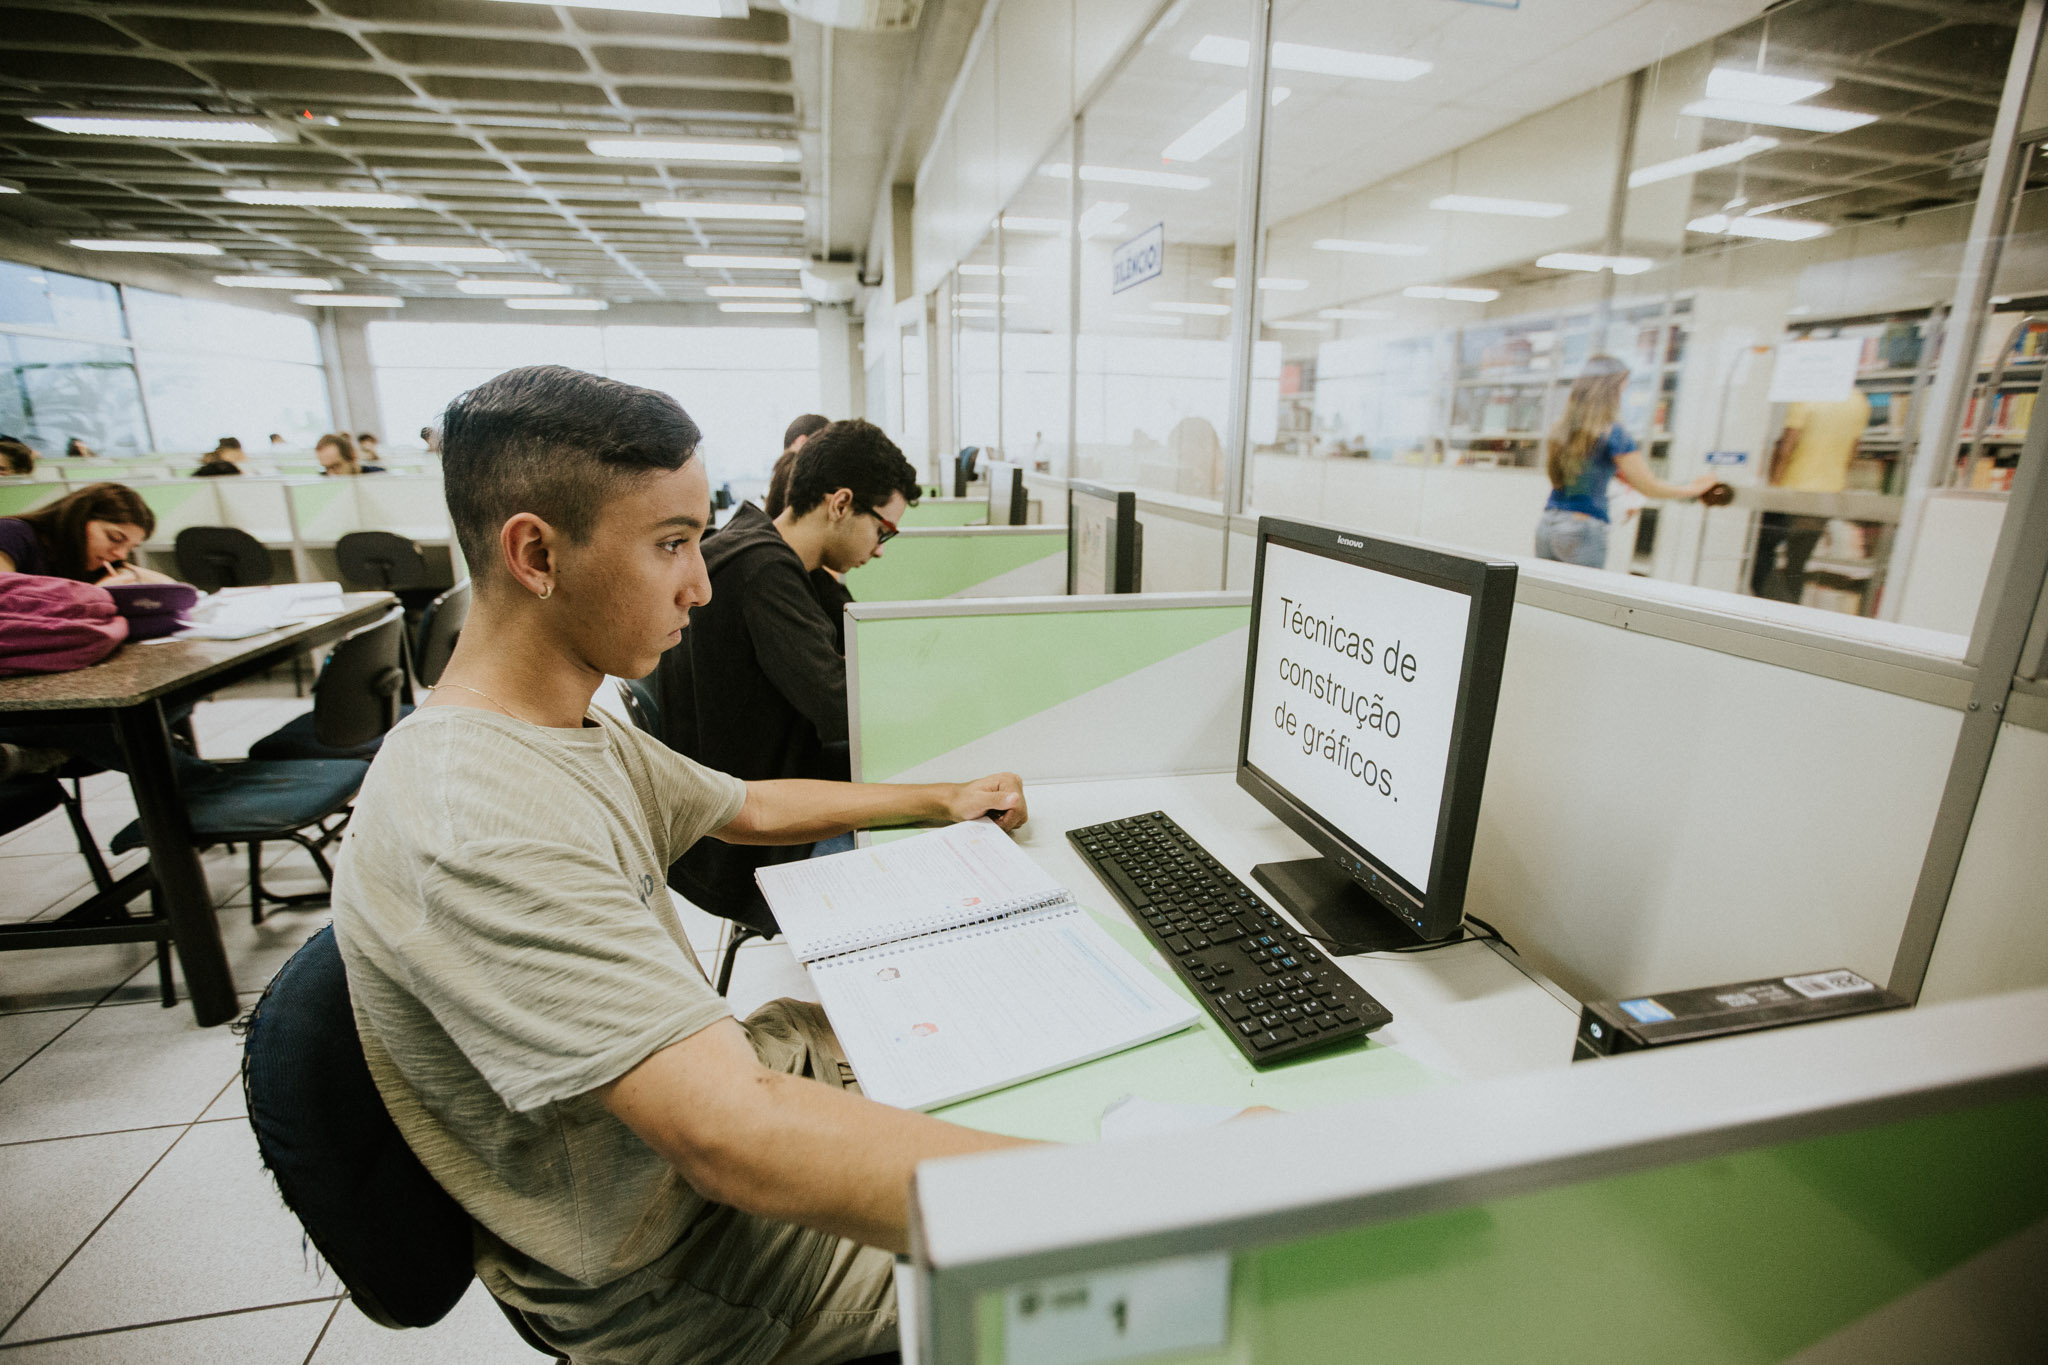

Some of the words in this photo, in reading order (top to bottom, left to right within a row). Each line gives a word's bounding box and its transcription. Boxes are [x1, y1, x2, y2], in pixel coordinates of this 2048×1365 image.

[1337, 534, 1364, 549] lenovo
[1280, 596, 1374, 665] Técnicas
[1383, 639, 1417, 683] de
[1279, 657, 1401, 739] construção
[1274, 701, 1297, 736] de
[1302, 723, 1398, 803] gráficos.
